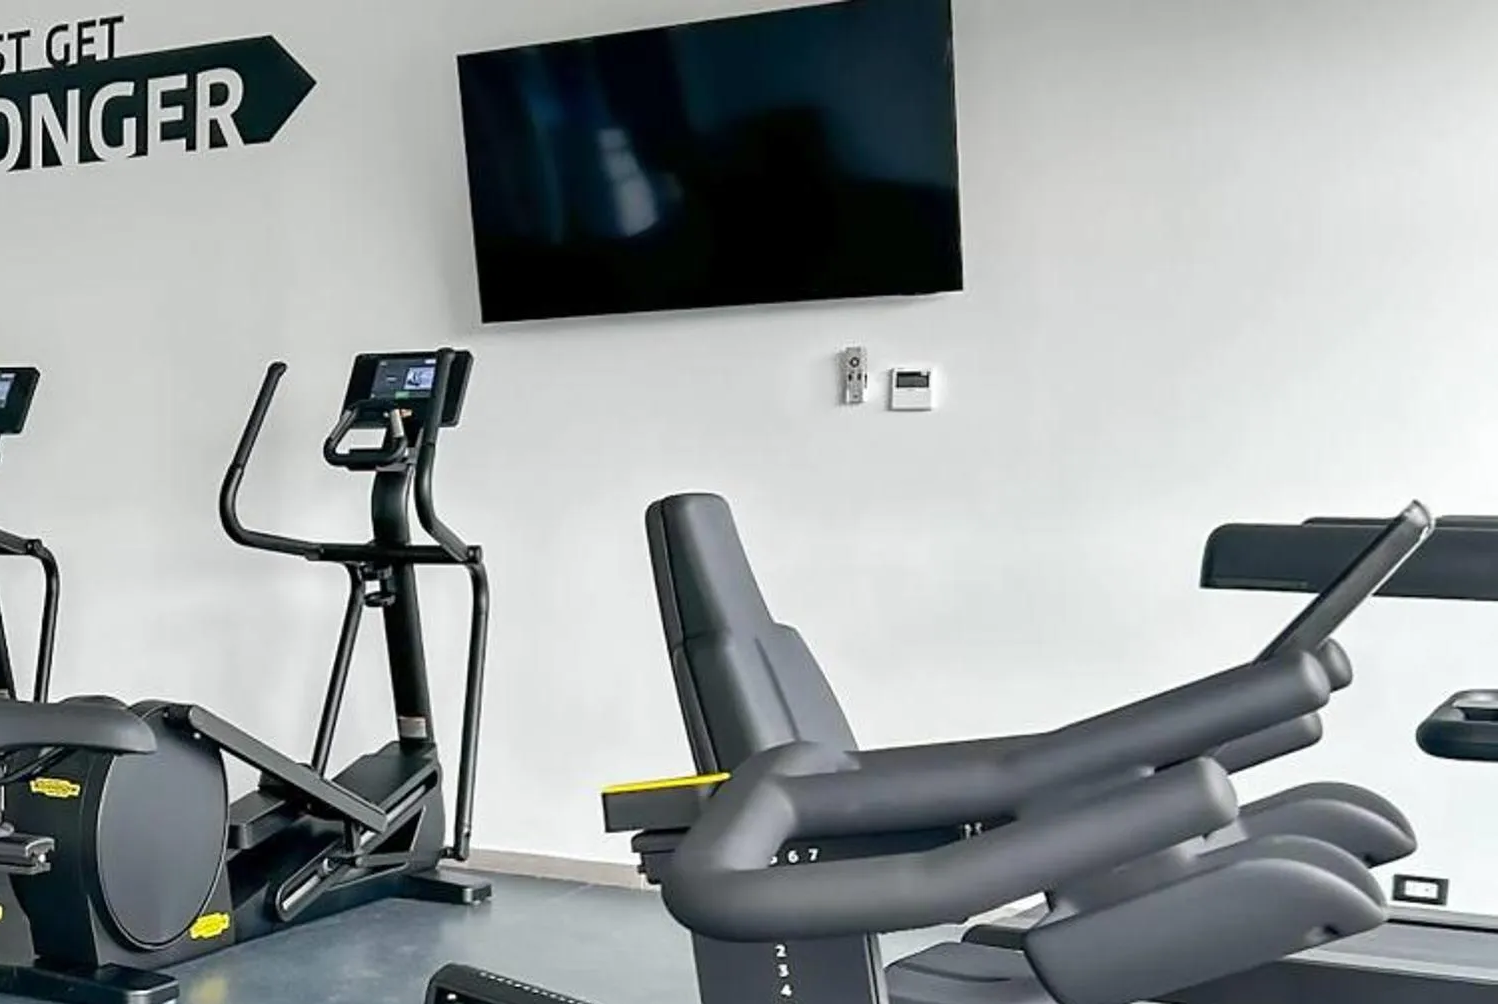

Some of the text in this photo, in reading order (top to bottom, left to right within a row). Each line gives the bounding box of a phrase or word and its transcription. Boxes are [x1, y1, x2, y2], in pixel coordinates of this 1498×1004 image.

[45, 15, 124, 67] GET
[788, 850, 799, 863] 6
[808, 848, 818, 861] 7
[775, 944, 787, 958] 2
[778, 963, 790, 978] 3
[780, 984, 792, 997] 4
